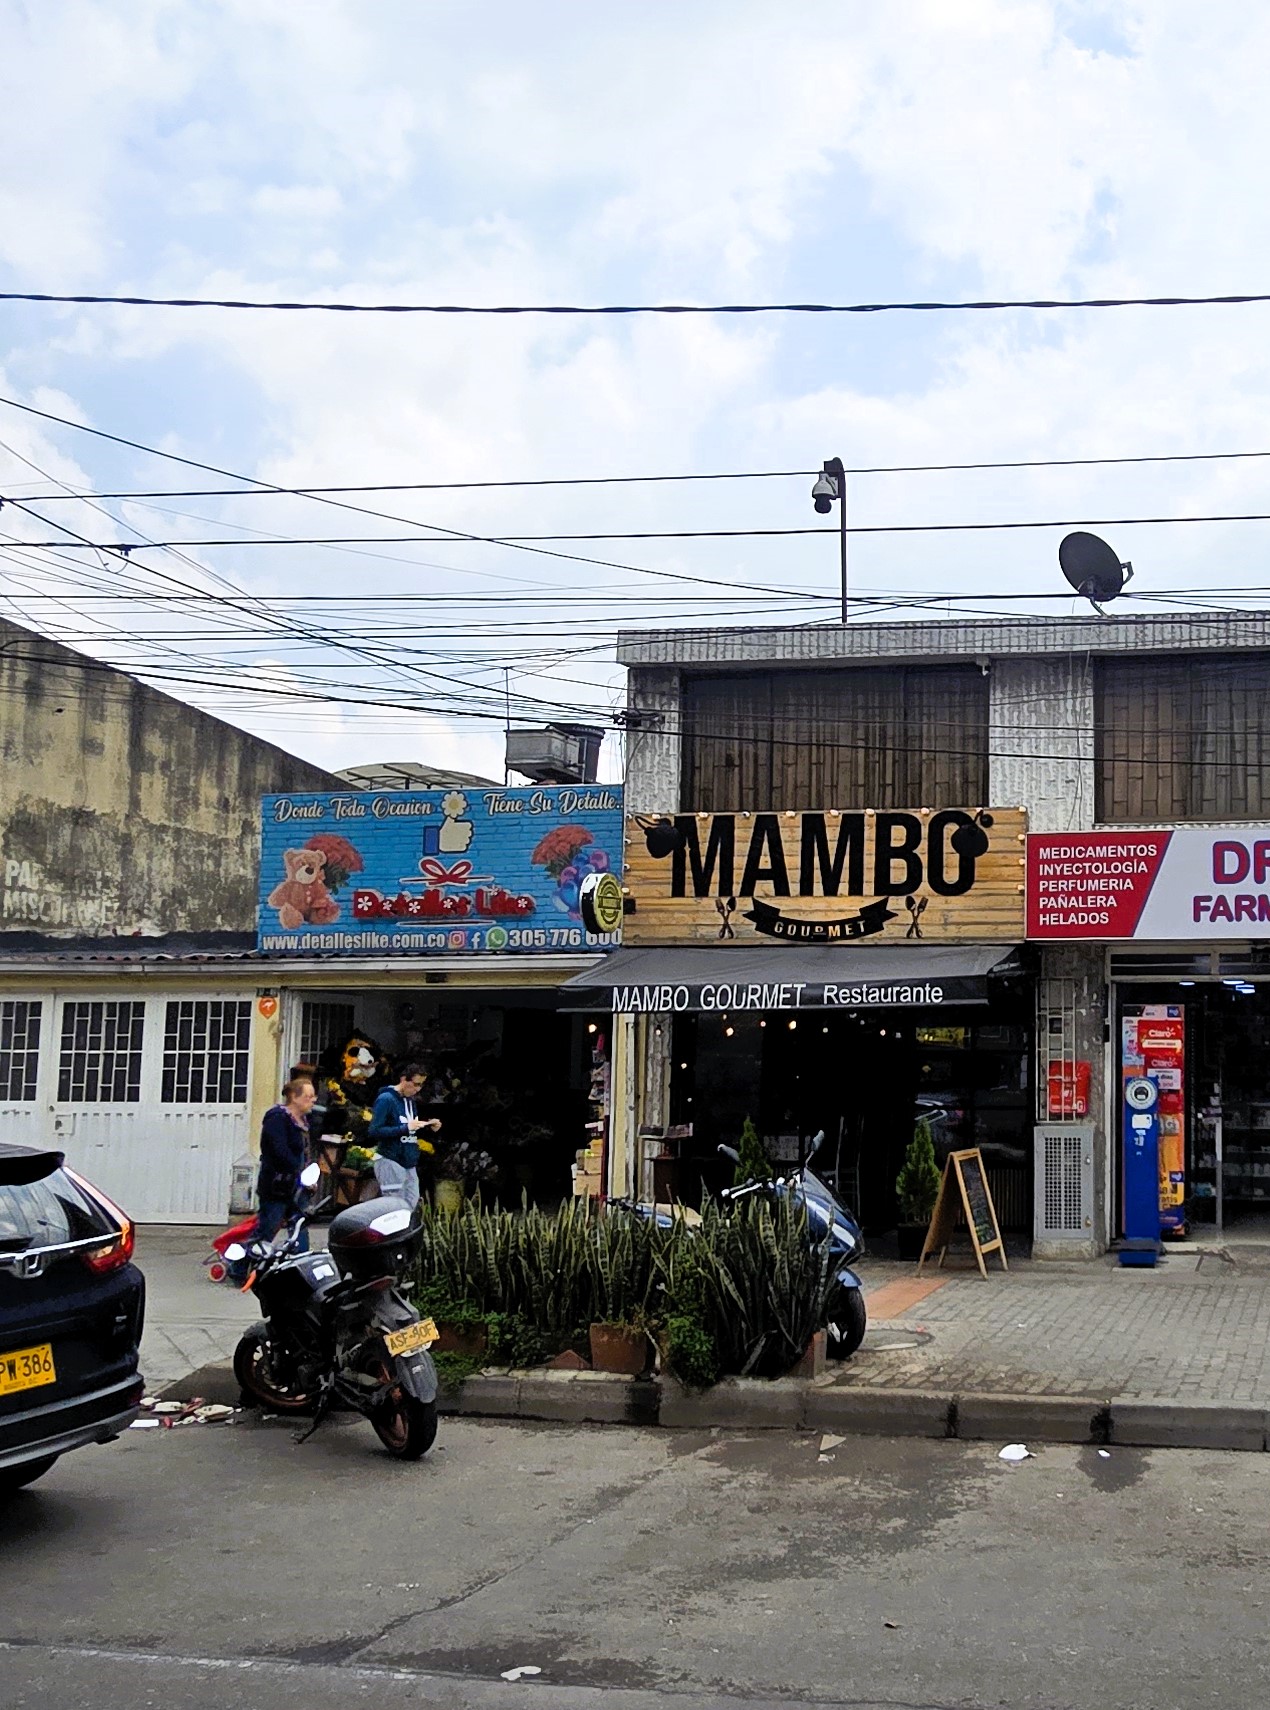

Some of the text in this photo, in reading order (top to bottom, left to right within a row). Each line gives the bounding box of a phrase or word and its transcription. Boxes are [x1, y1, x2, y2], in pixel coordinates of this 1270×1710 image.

[274, 798, 324, 822] Donde
[330, 797, 366, 820] Toda
[483, 792, 524, 815] Tiene
[529, 791, 551, 814] Su
[671, 810, 976, 898] MAMBO
[1040, 844, 1158, 859] MEDICAMENTOS
[1040, 859, 1148, 876] INYECTOLOGÍA
[1040, 878, 1134, 892] PERFUMERIA
[353, 885, 536, 918] Detalles Like
[1040, 894, 1118, 909] PAÑALERA
[1040, 912, 1110, 925] HELADOS
[774, 920, 867, 937] GOURMET
[263, 931, 446, 950] www.detalleslike.com.co
[509, 929, 546, 947] 305
[550, 928, 582, 946] 776
[612, 982, 943, 1012] MAMBO GOURMET Restaurante
[1148, 1029, 1172, 1037] Claro
[1151, 1059, 1174, 1067] Claro
